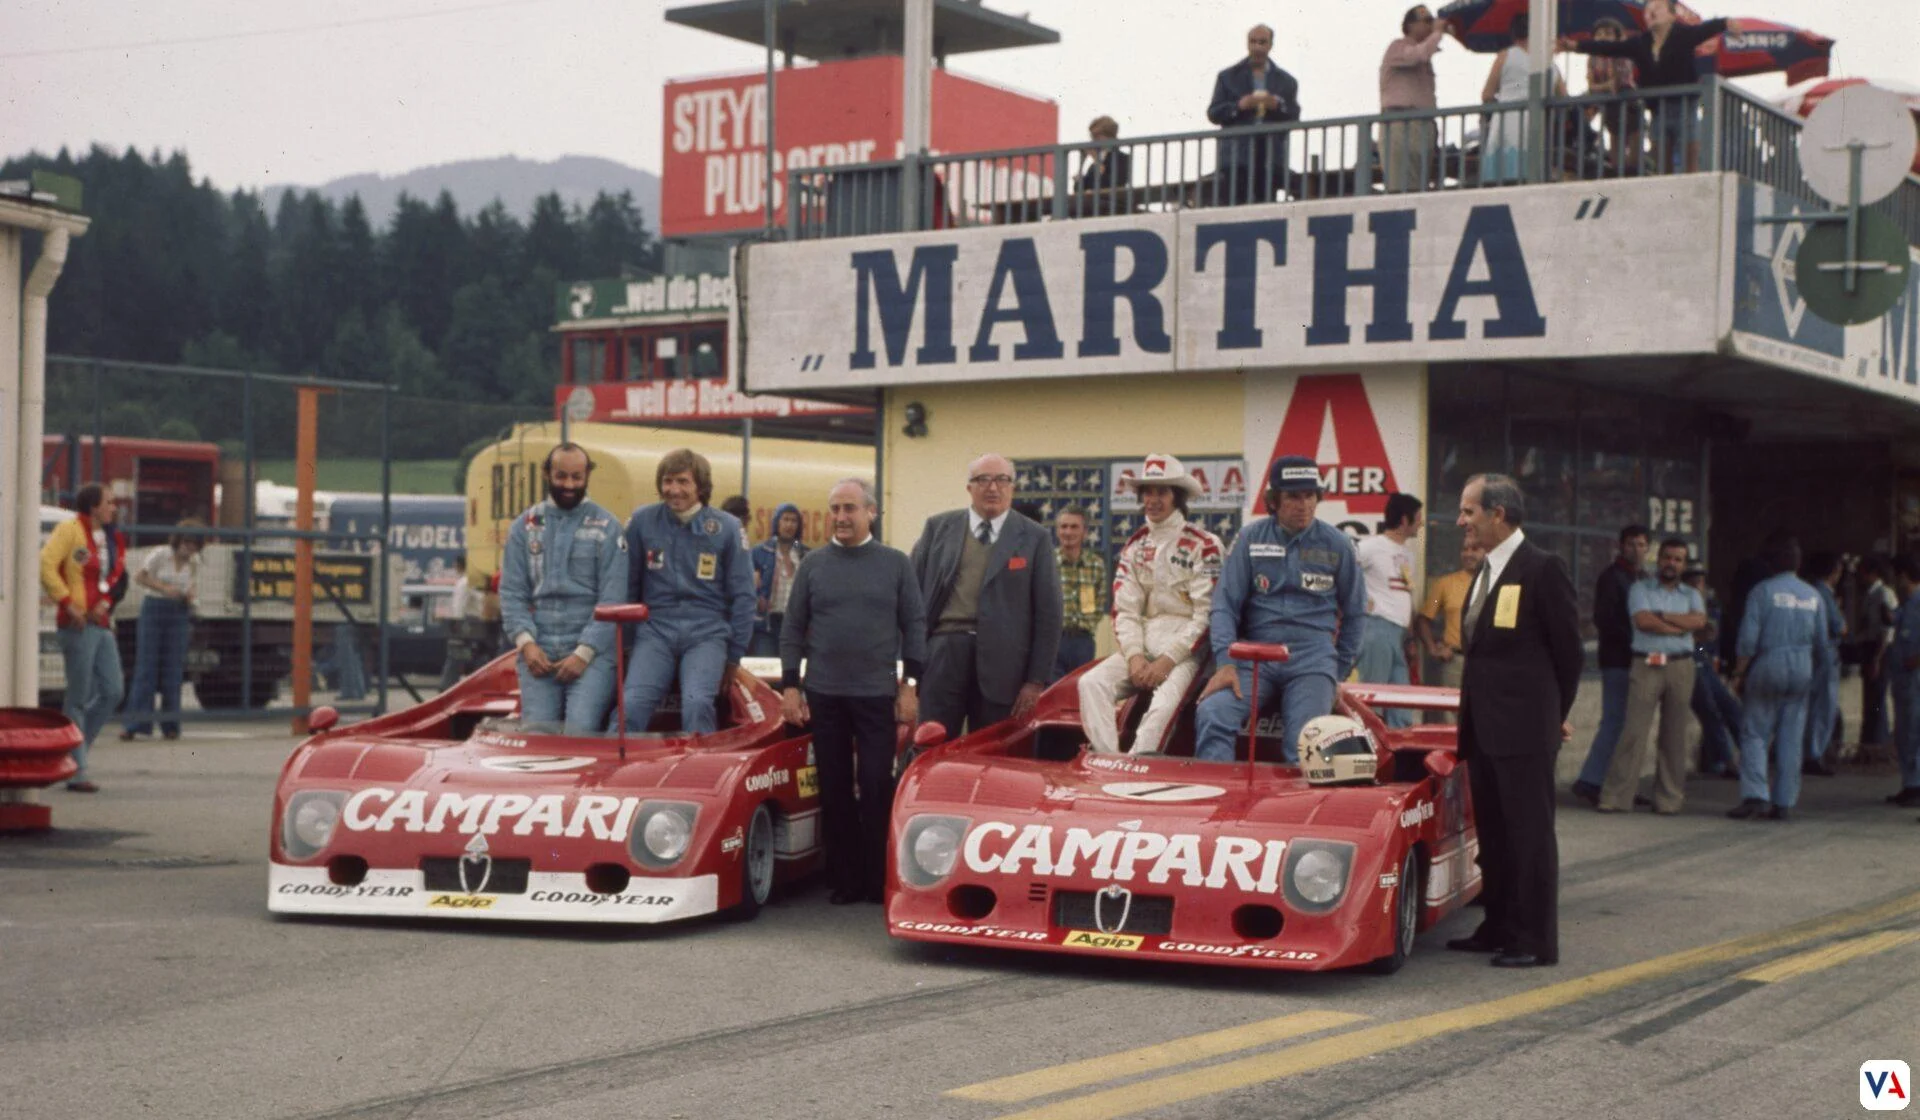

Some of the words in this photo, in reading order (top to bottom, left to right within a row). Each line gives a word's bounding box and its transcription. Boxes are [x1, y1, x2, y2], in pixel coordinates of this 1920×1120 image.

[342, 787, 640, 842] CAMPARI
[963, 821, 1287, 894] CAMPARI
[277, 882, 415, 898] GOODYEAR
[530, 890, 674, 906] GOODYEAR
[431, 895, 493, 908] Agip
[898, 920, 1048, 941] GOODYEAR
[1071, 931, 1135, 949] Agip
[1158, 941, 1319, 961] GOODYEAR
